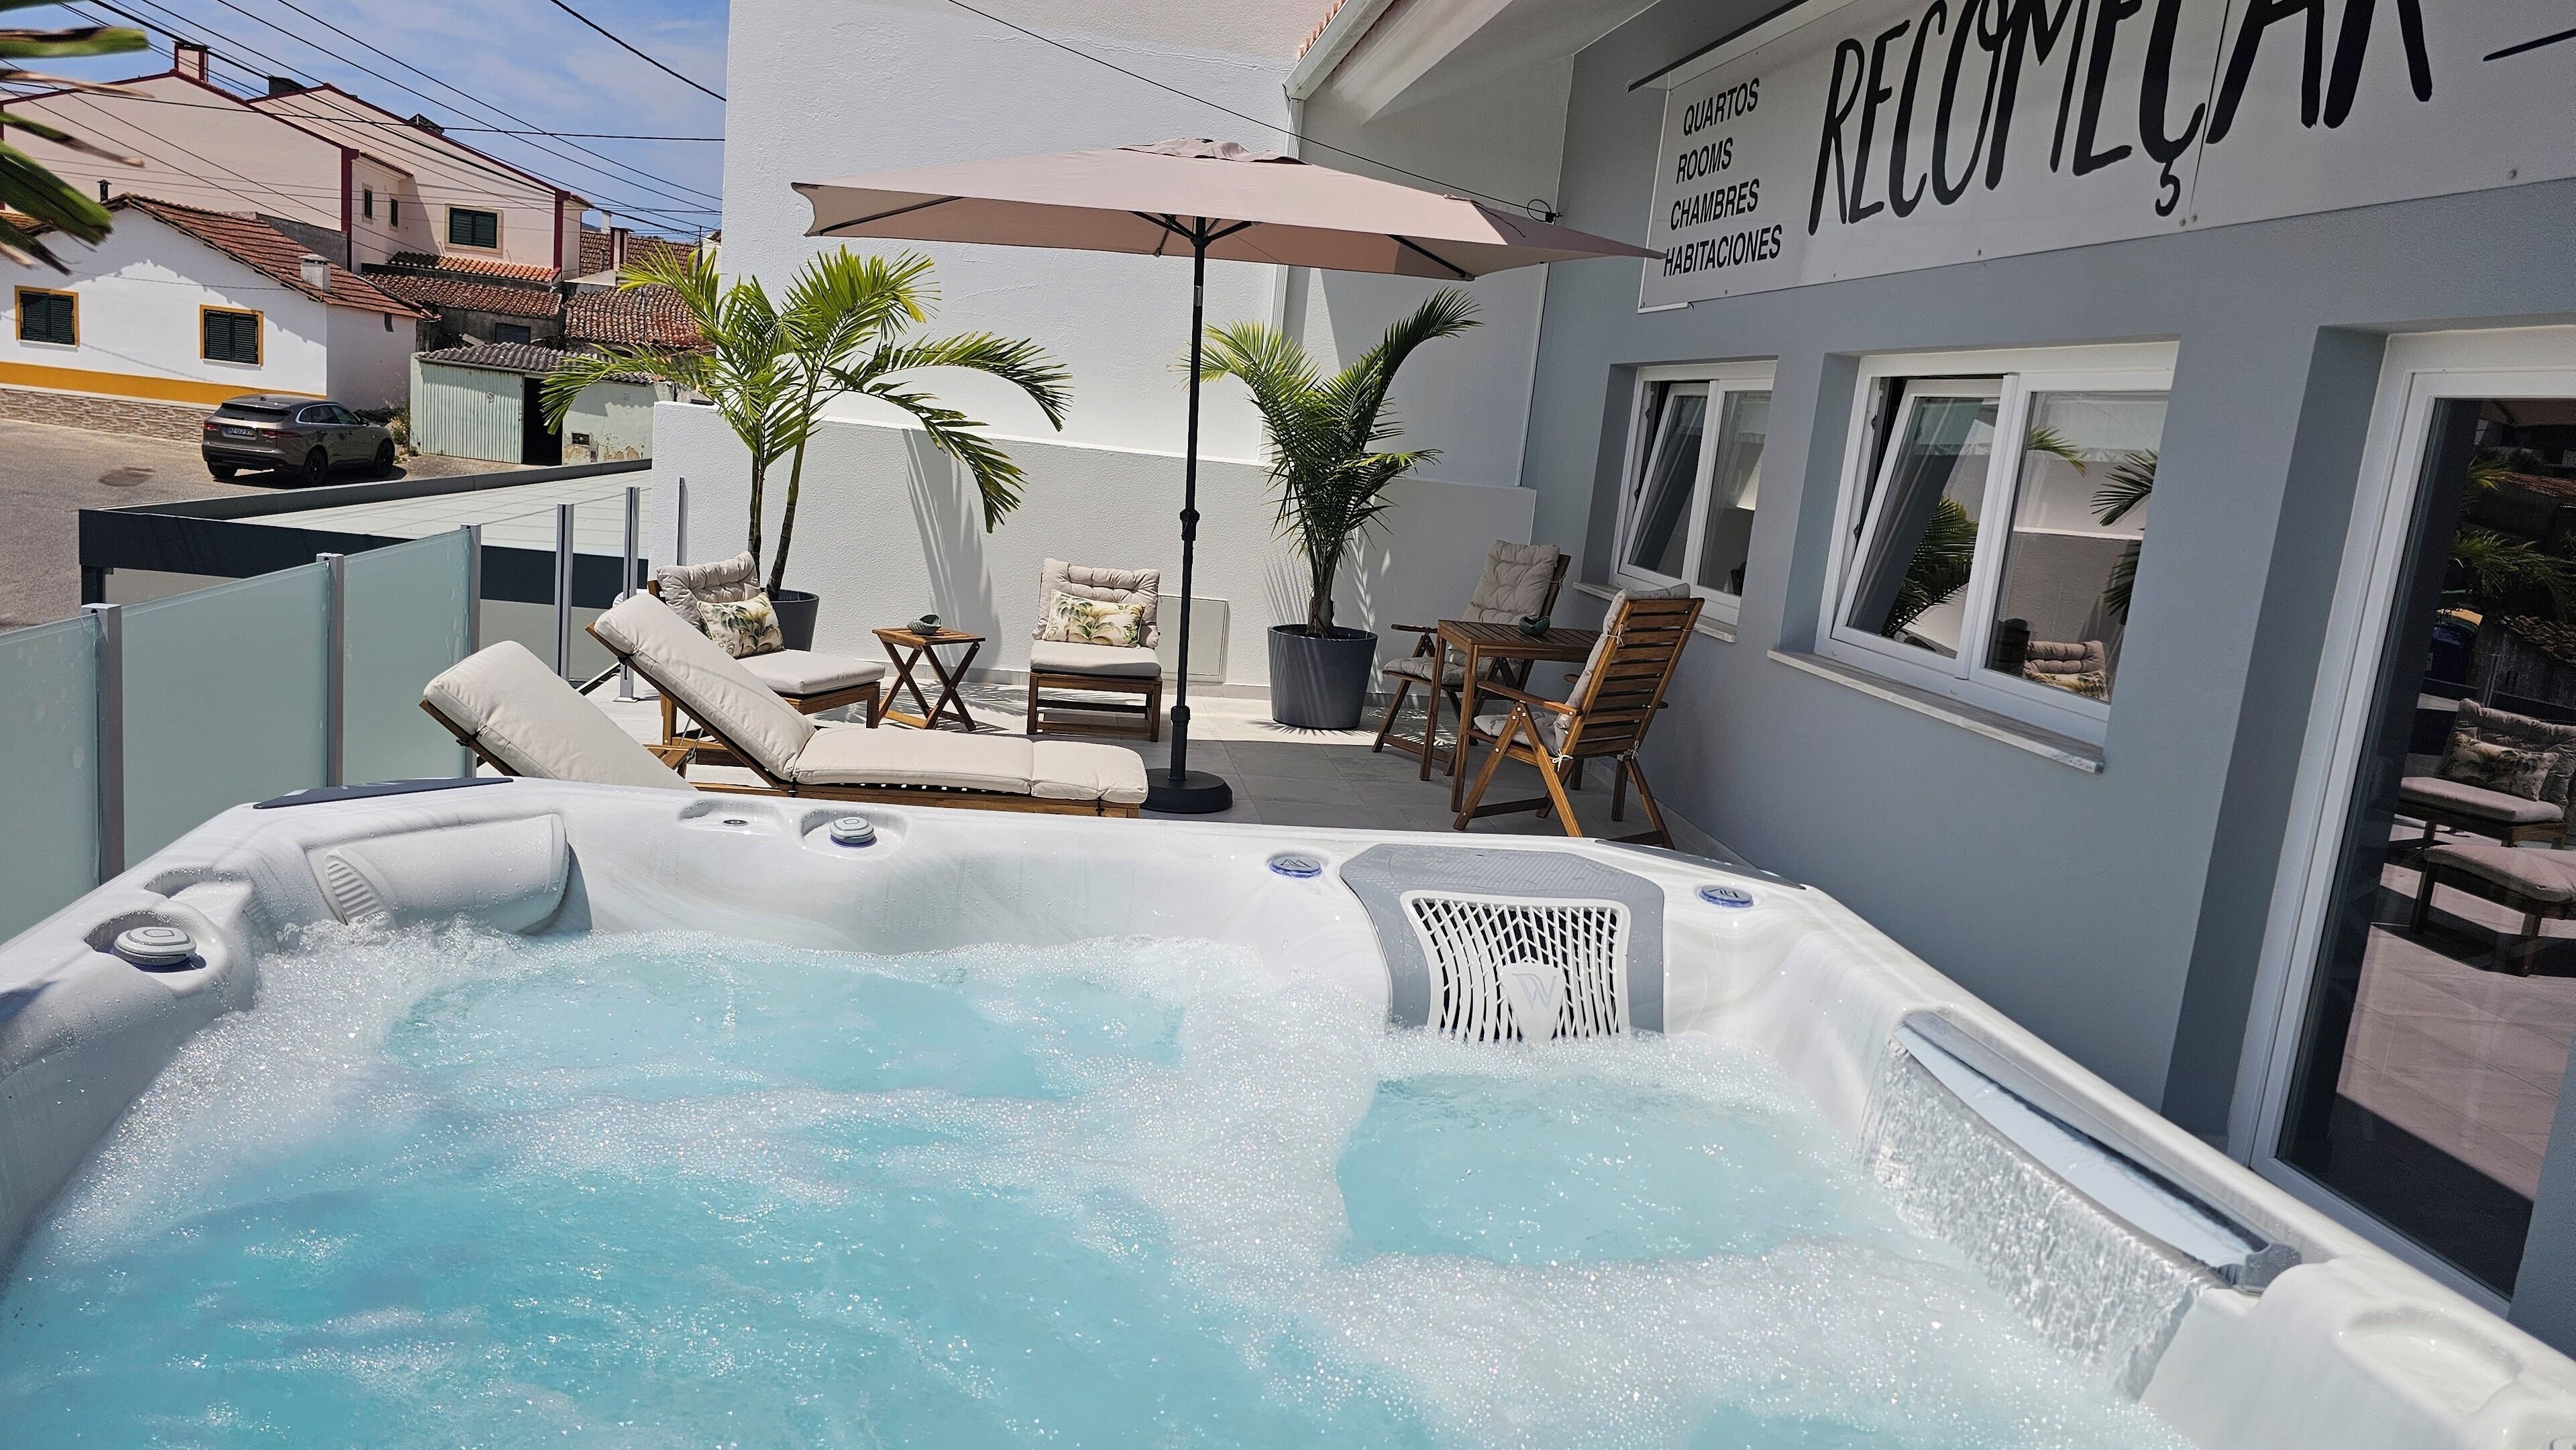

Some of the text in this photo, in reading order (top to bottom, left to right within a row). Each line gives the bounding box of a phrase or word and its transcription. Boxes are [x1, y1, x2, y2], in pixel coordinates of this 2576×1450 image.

[1683, 77, 1760, 136] QUARTOS
[1676, 137, 1733, 185] ROOMS
[1670, 178, 1760, 231] CHAMBRES
[1663, 224, 1782, 277] HABITACIONES
